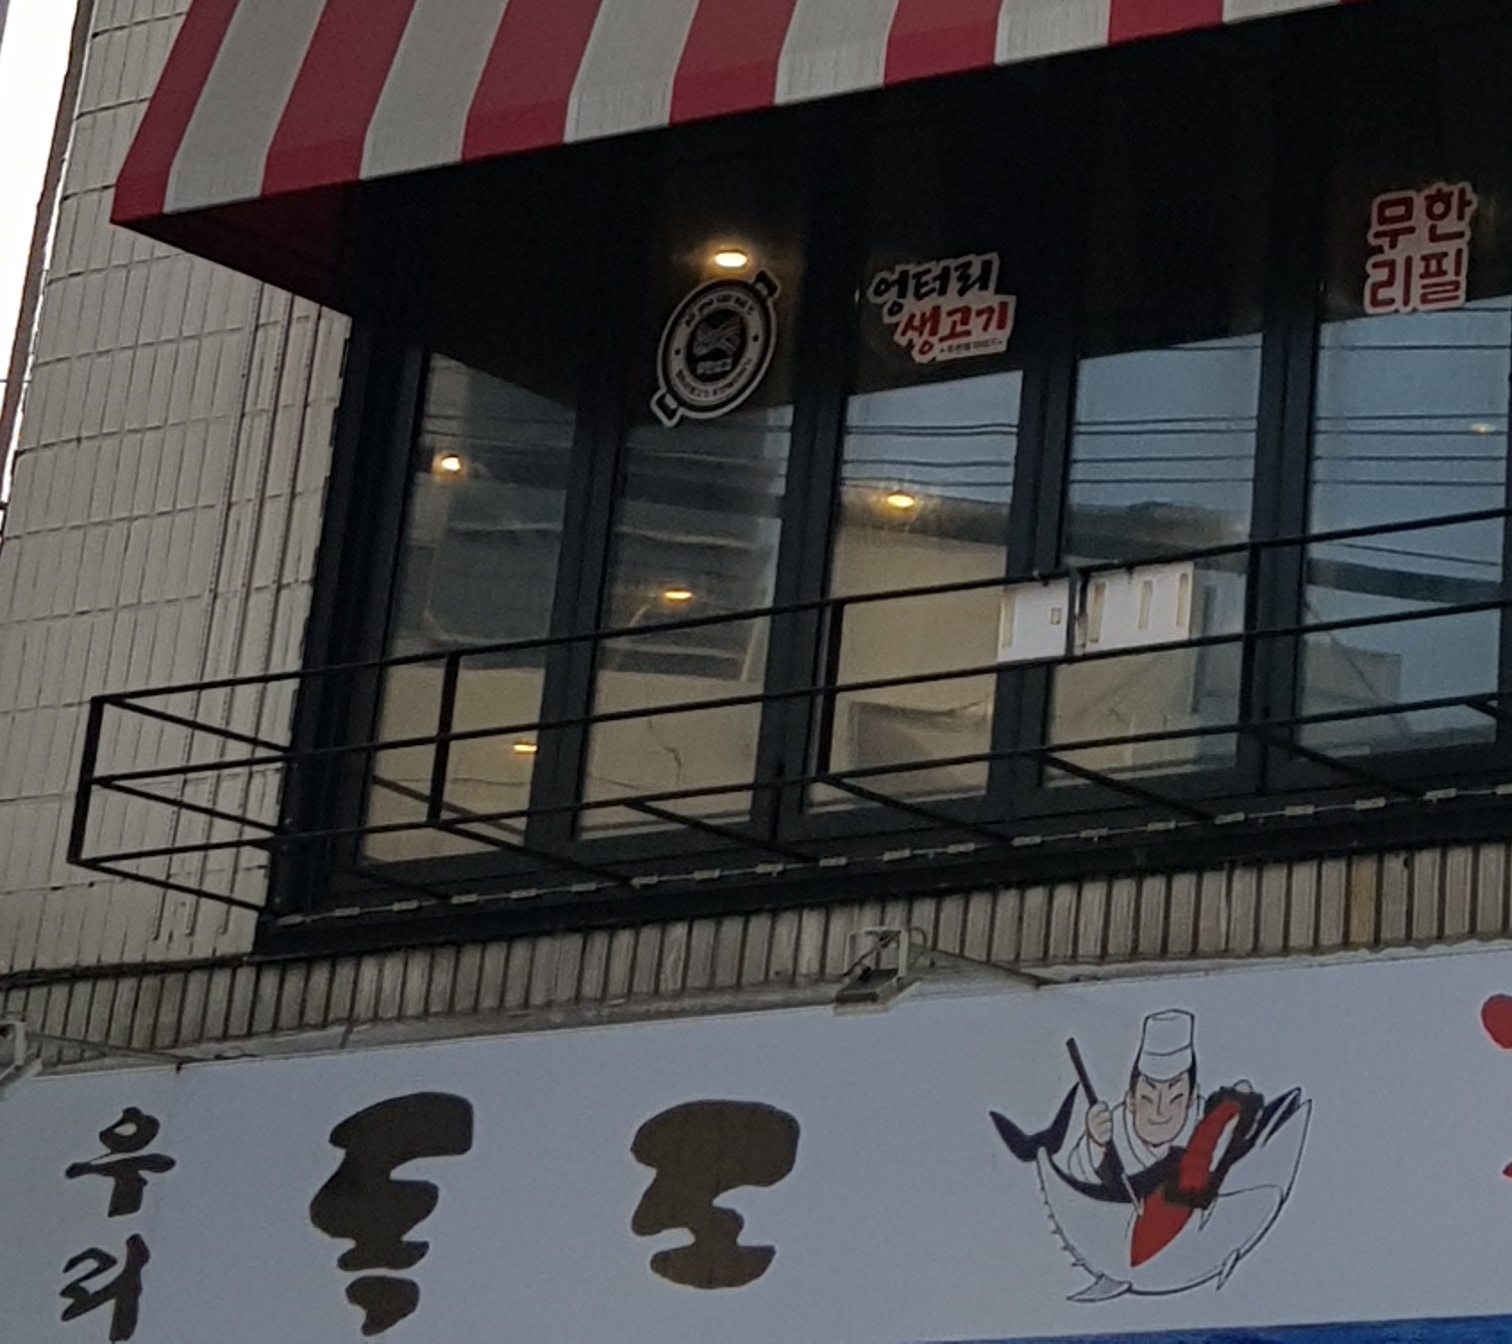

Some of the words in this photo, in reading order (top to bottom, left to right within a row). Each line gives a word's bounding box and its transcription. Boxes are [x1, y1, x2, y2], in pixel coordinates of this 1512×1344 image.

[1373, 187, 1473, 250] 무한
[873, 259, 994, 317] 엉터리
[1369, 247, 1463, 308] 리필
[900, 300, 1009, 356] 생고기
